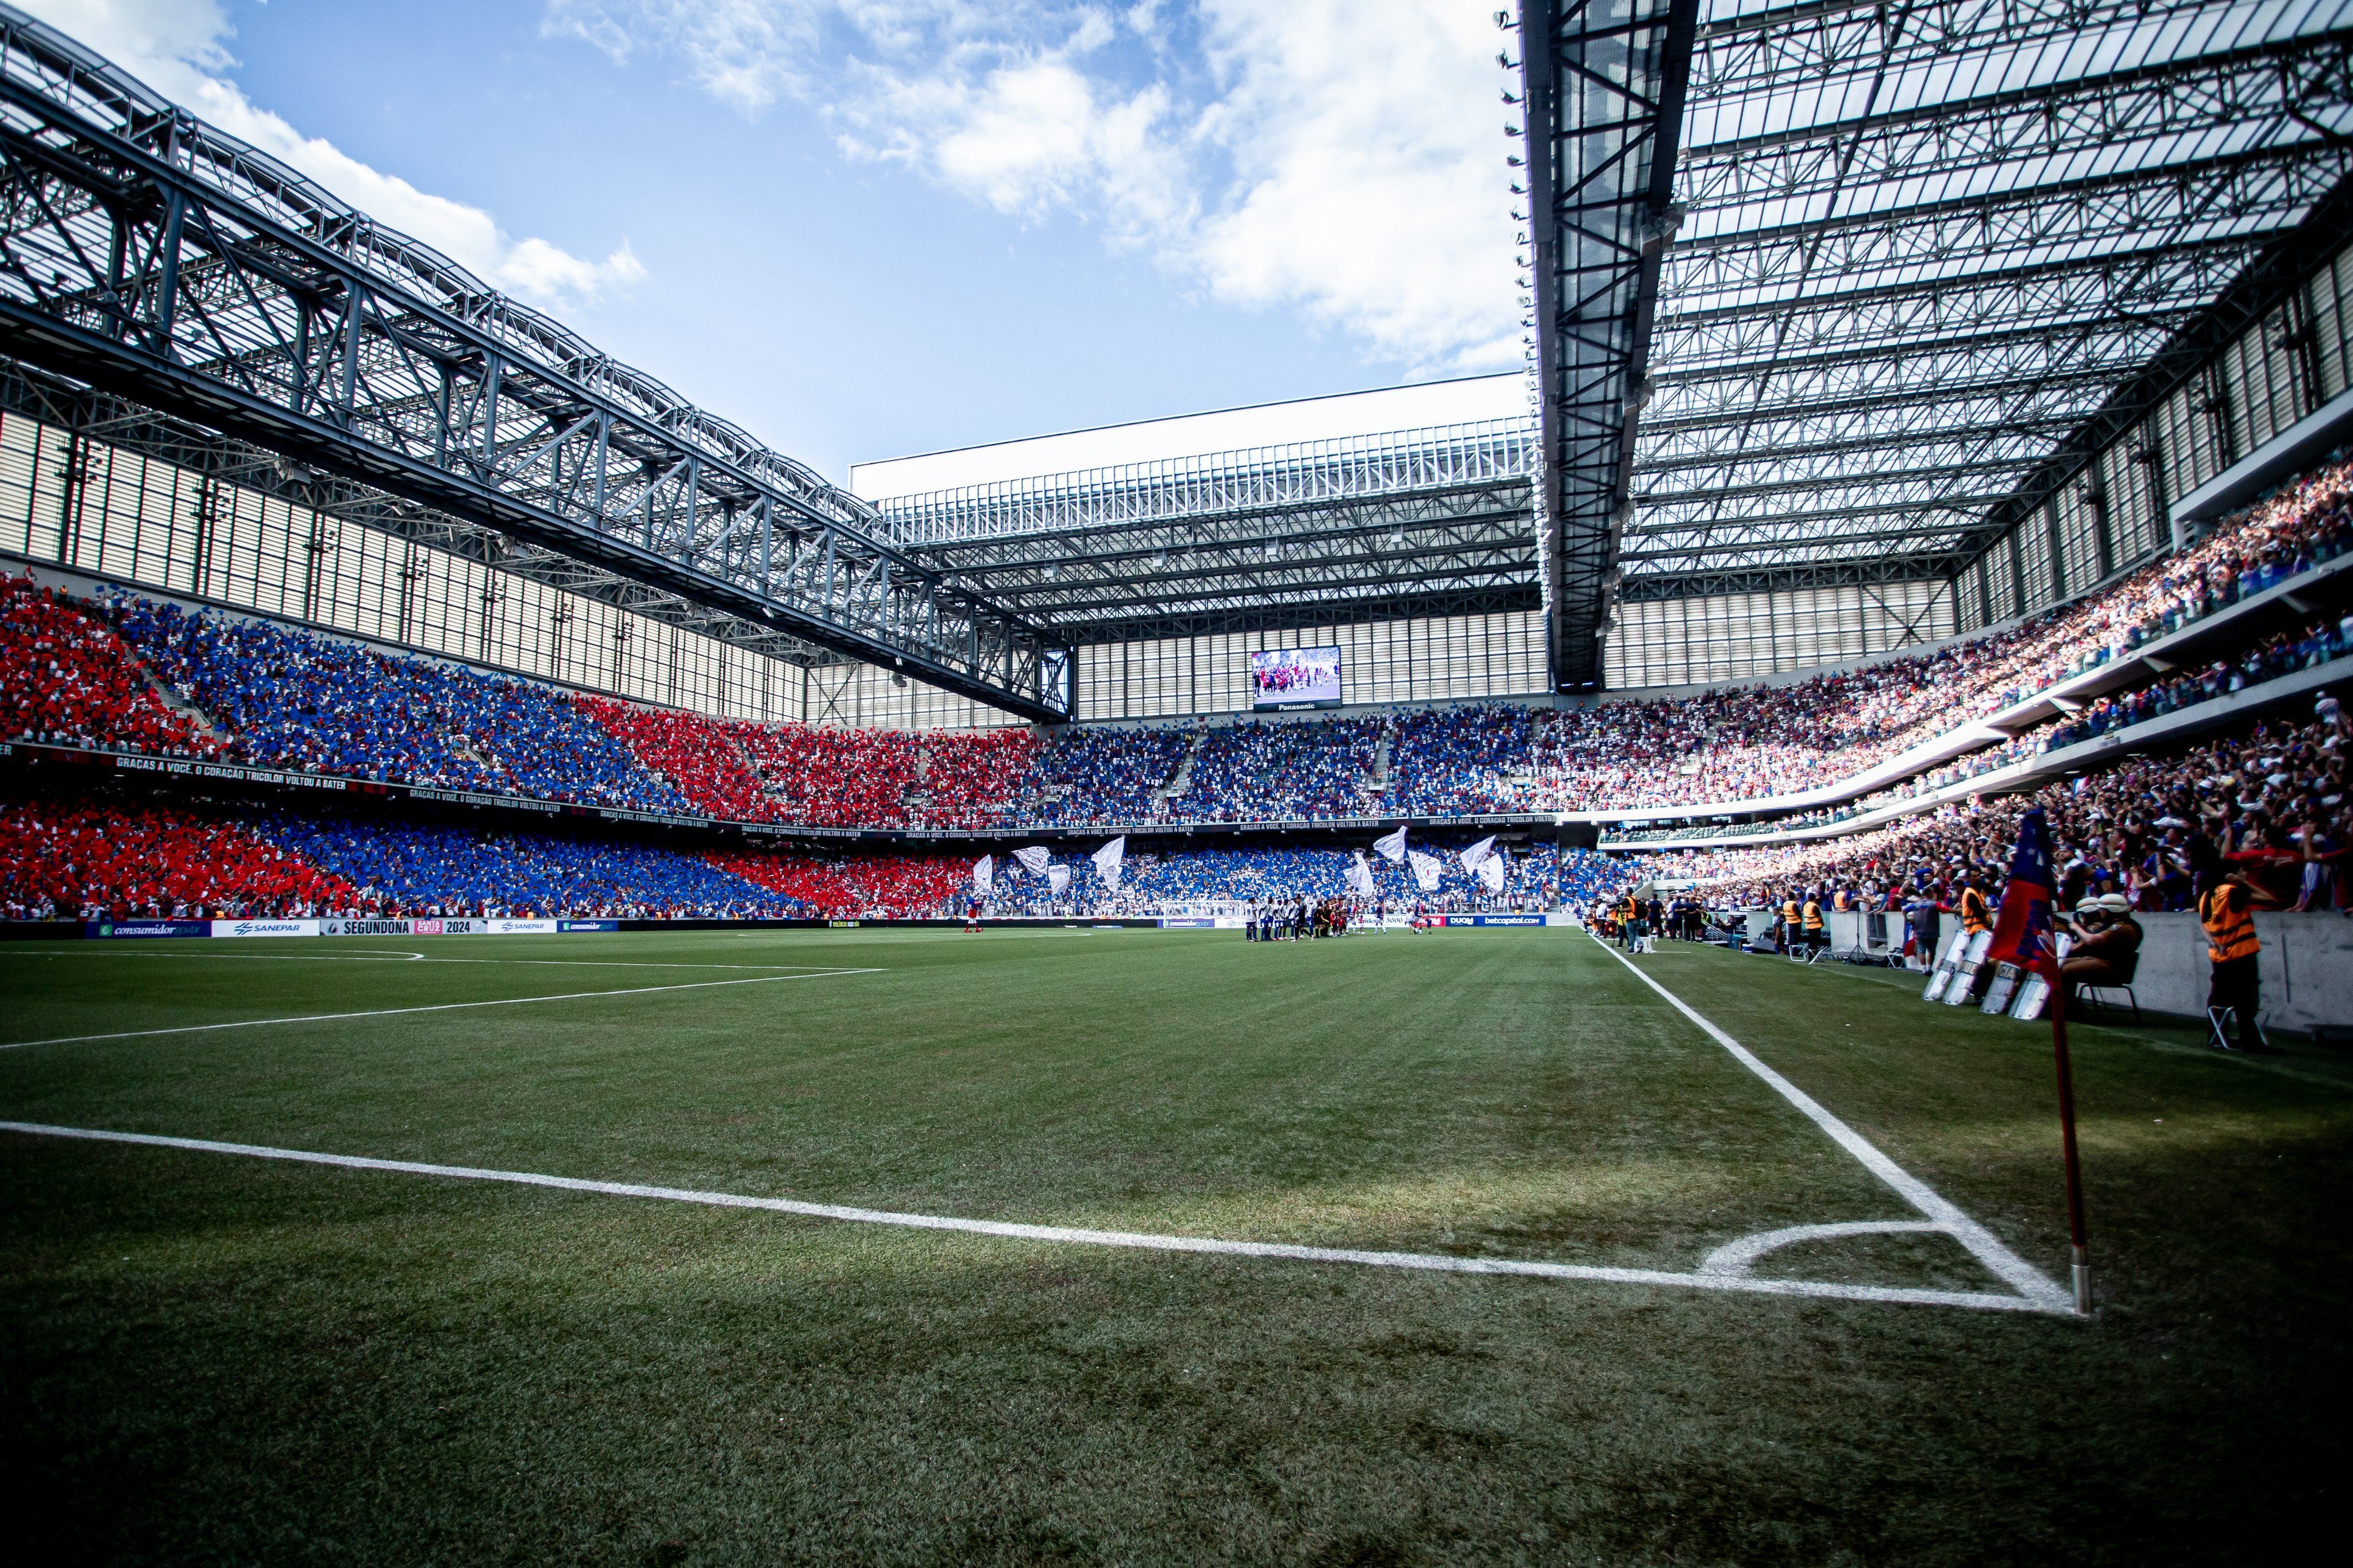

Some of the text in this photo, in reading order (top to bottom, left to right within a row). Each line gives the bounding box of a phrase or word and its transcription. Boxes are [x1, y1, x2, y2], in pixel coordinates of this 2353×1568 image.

[117, 757, 156, 770] GRAÇAS
[157, 762, 164, 771] A
[195, 765, 202, 775] O
[246, 771, 284, 783] TRICOLOR
[286, 775, 314, 787] VOLTOU
[315, 779, 321, 787] A
[323, 779, 346, 790] BATER
[493, 798, 519, 808] TRICOLOR
[519, 801, 539, 810] VOLTOU
[545, 804, 561, 812] BATER
[344, 921, 409, 934] SEGUNDONA
[447, 921, 470, 933] 2024
